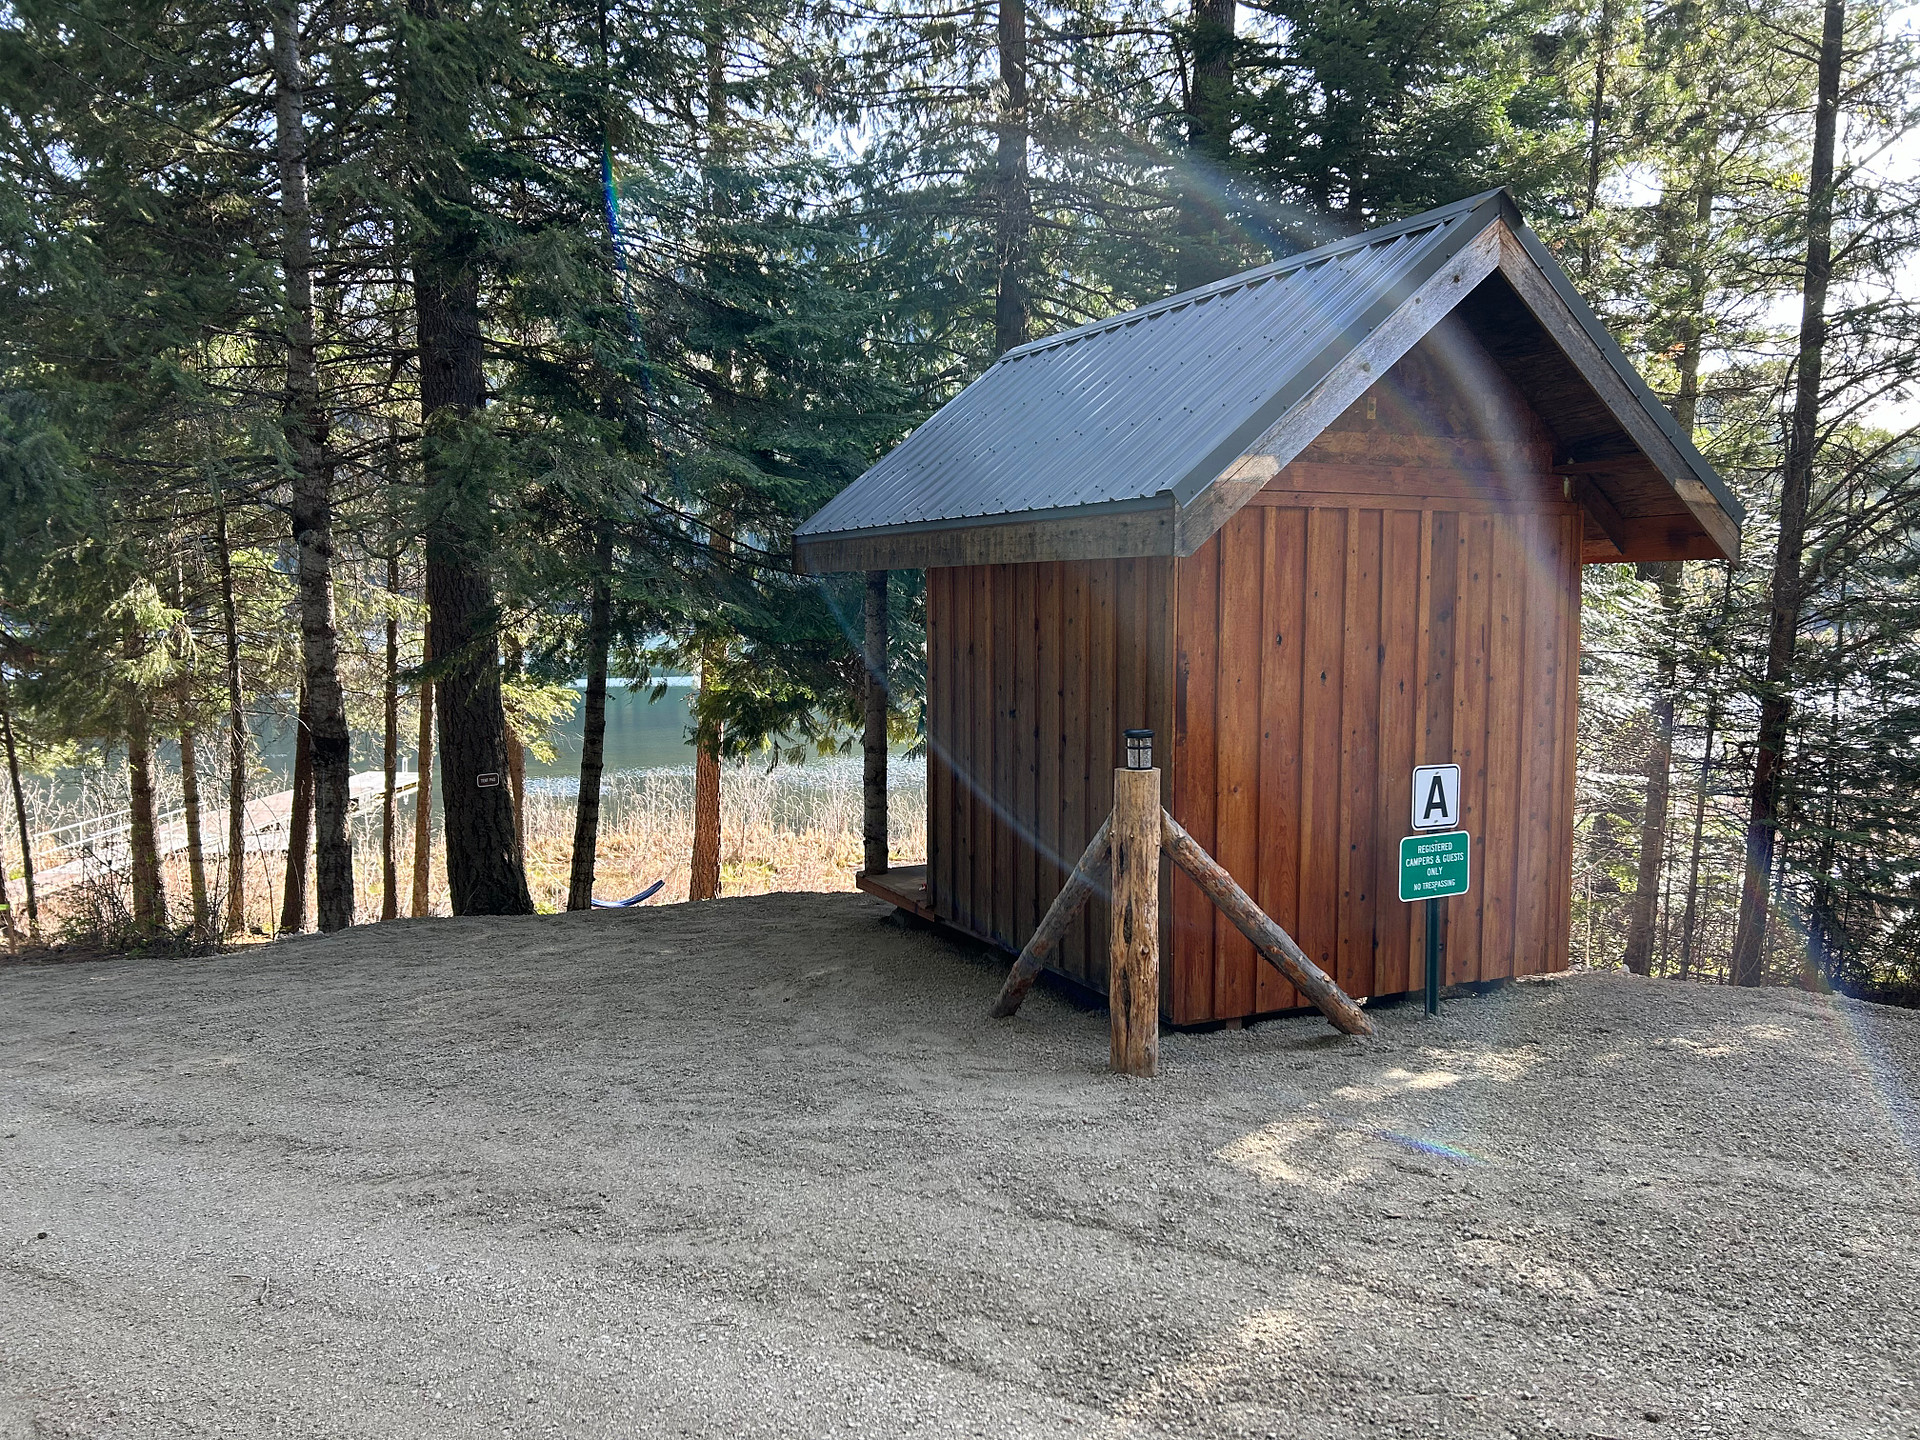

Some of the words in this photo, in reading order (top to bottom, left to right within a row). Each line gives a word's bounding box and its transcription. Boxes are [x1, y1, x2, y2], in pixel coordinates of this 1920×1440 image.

[1423, 775, 1449, 819] A
[1417, 842, 1453, 854] REGISTERED
[1405, 855, 1434, 867] CAMPERS
[1435, 855, 1441, 864] &
[1442, 852, 1464, 863] GUESTS
[1426, 866, 1443, 876] ONLY
[1413, 883, 1421, 891] NO
[1422, 879, 1456, 889] TRESPASSING
